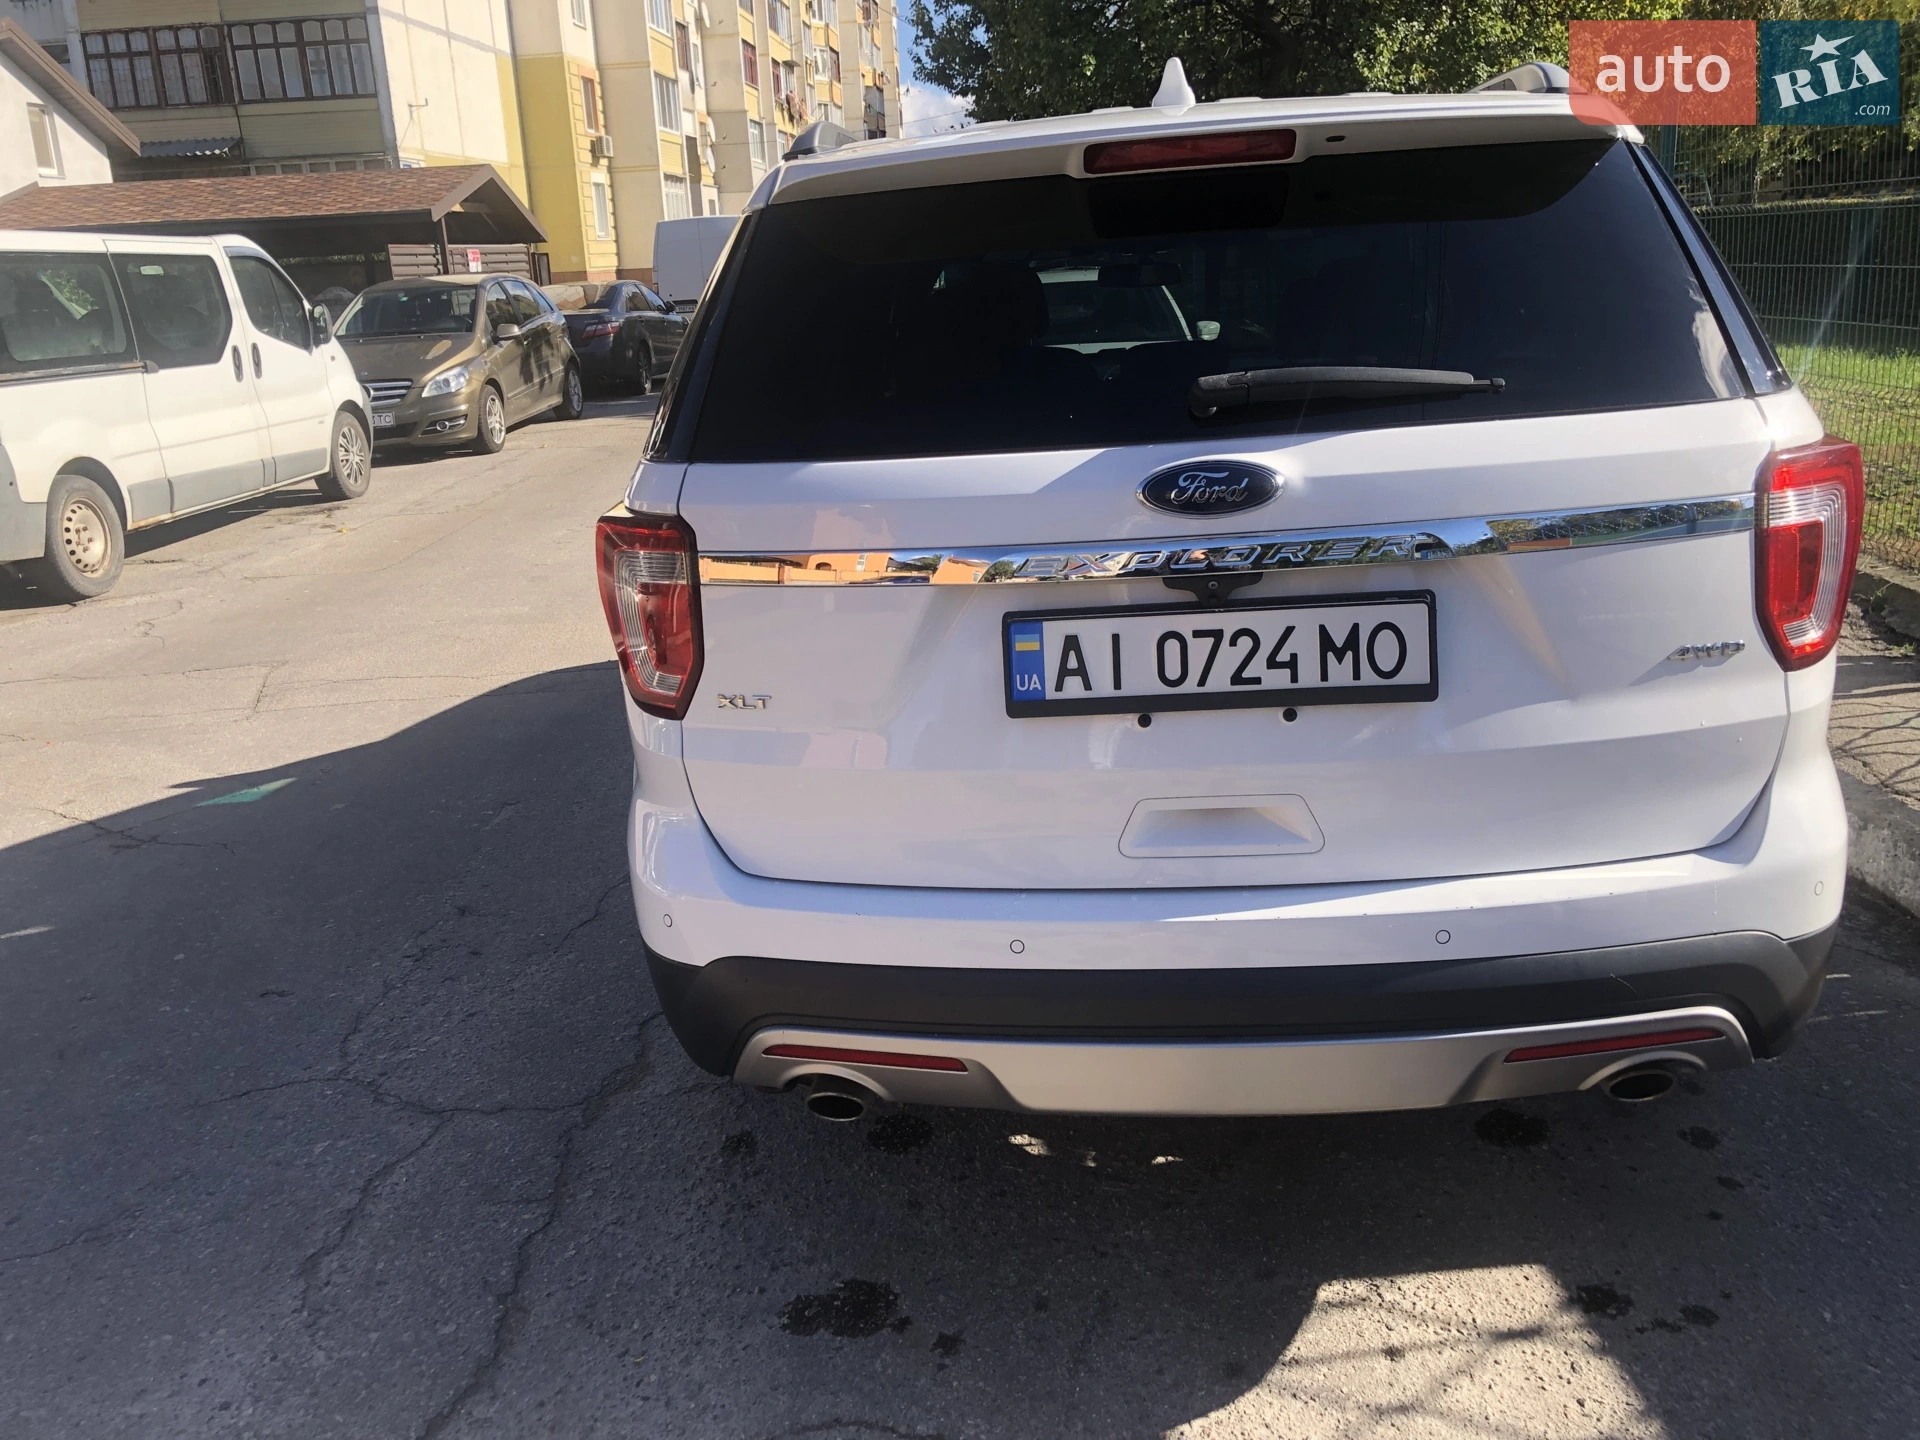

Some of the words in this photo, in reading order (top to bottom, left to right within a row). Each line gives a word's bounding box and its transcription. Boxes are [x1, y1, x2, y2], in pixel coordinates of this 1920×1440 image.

[377, 414, 392, 424] TC
[1170, 471, 1249, 505] Ford
[1014, 533, 1417, 577] EXPLORER
[1054, 632, 1122, 692] AI
[1156, 625, 1299, 688] 0724
[1318, 620, 1408, 683] MO
[1015, 673, 1042, 692] UA
[717, 694, 772, 710] XLT
